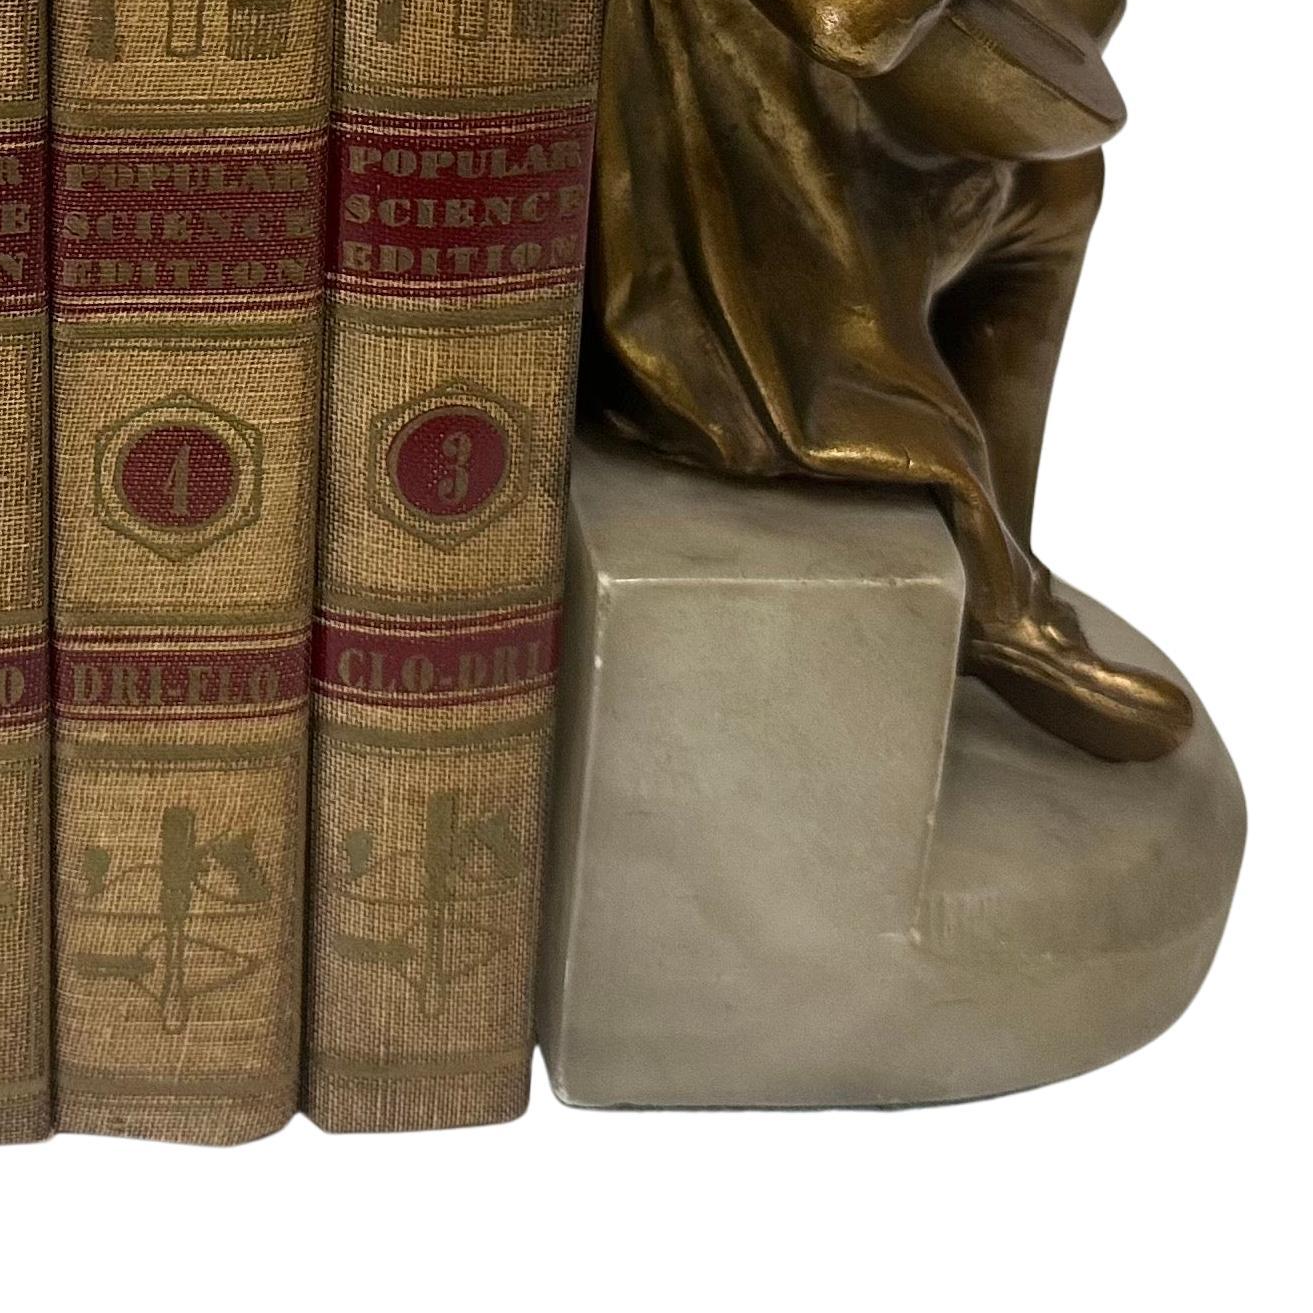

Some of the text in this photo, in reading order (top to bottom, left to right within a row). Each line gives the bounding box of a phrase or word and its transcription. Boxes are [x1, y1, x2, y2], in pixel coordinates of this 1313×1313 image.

[65, 160, 309, 192] POPULAR
[349, 140, 581, 179] POPULAR
[63, 205, 315, 241] SCIENCE
[345, 184, 584, 228] SCIENCE
[63, 256, 309, 290] EDITION
[343, 234, 577, 277] EDITION
[437, 430, 472, 505] 3
[72, 662, 280, 706] DRI-FLO
[338, 641, 541, 692] CLO-DRI
